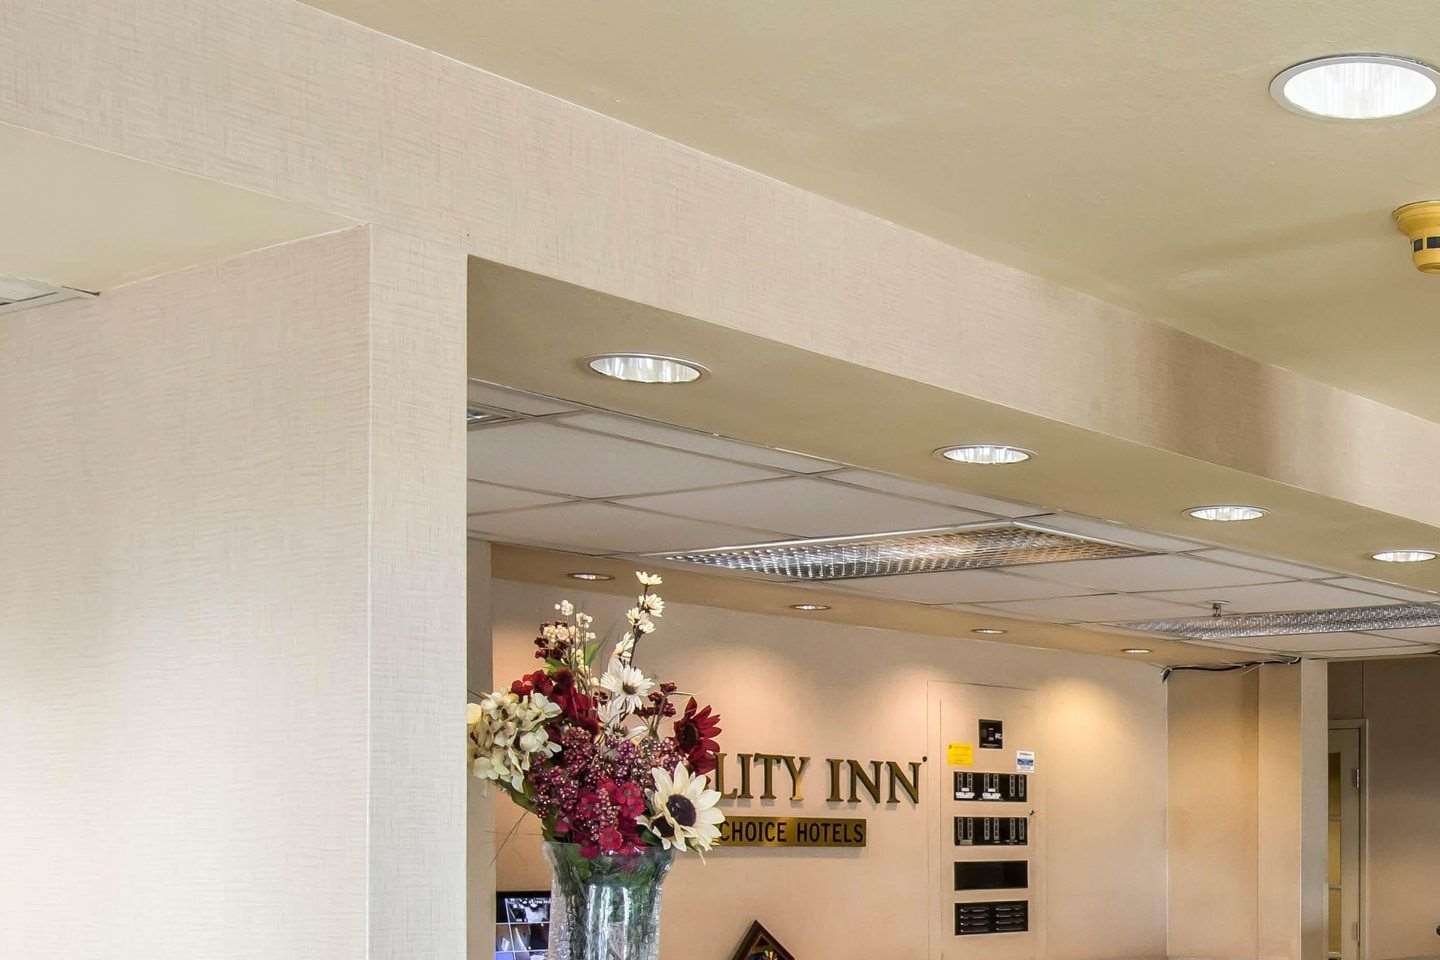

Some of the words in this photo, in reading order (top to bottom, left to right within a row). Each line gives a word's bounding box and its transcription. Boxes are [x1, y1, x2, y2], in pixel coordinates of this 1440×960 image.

[714, 752, 811, 801] LITY
[825, 758, 921, 804] INN
[719, 821, 788, 842] CHOICE
[796, 822, 864, 843] HOTELS
